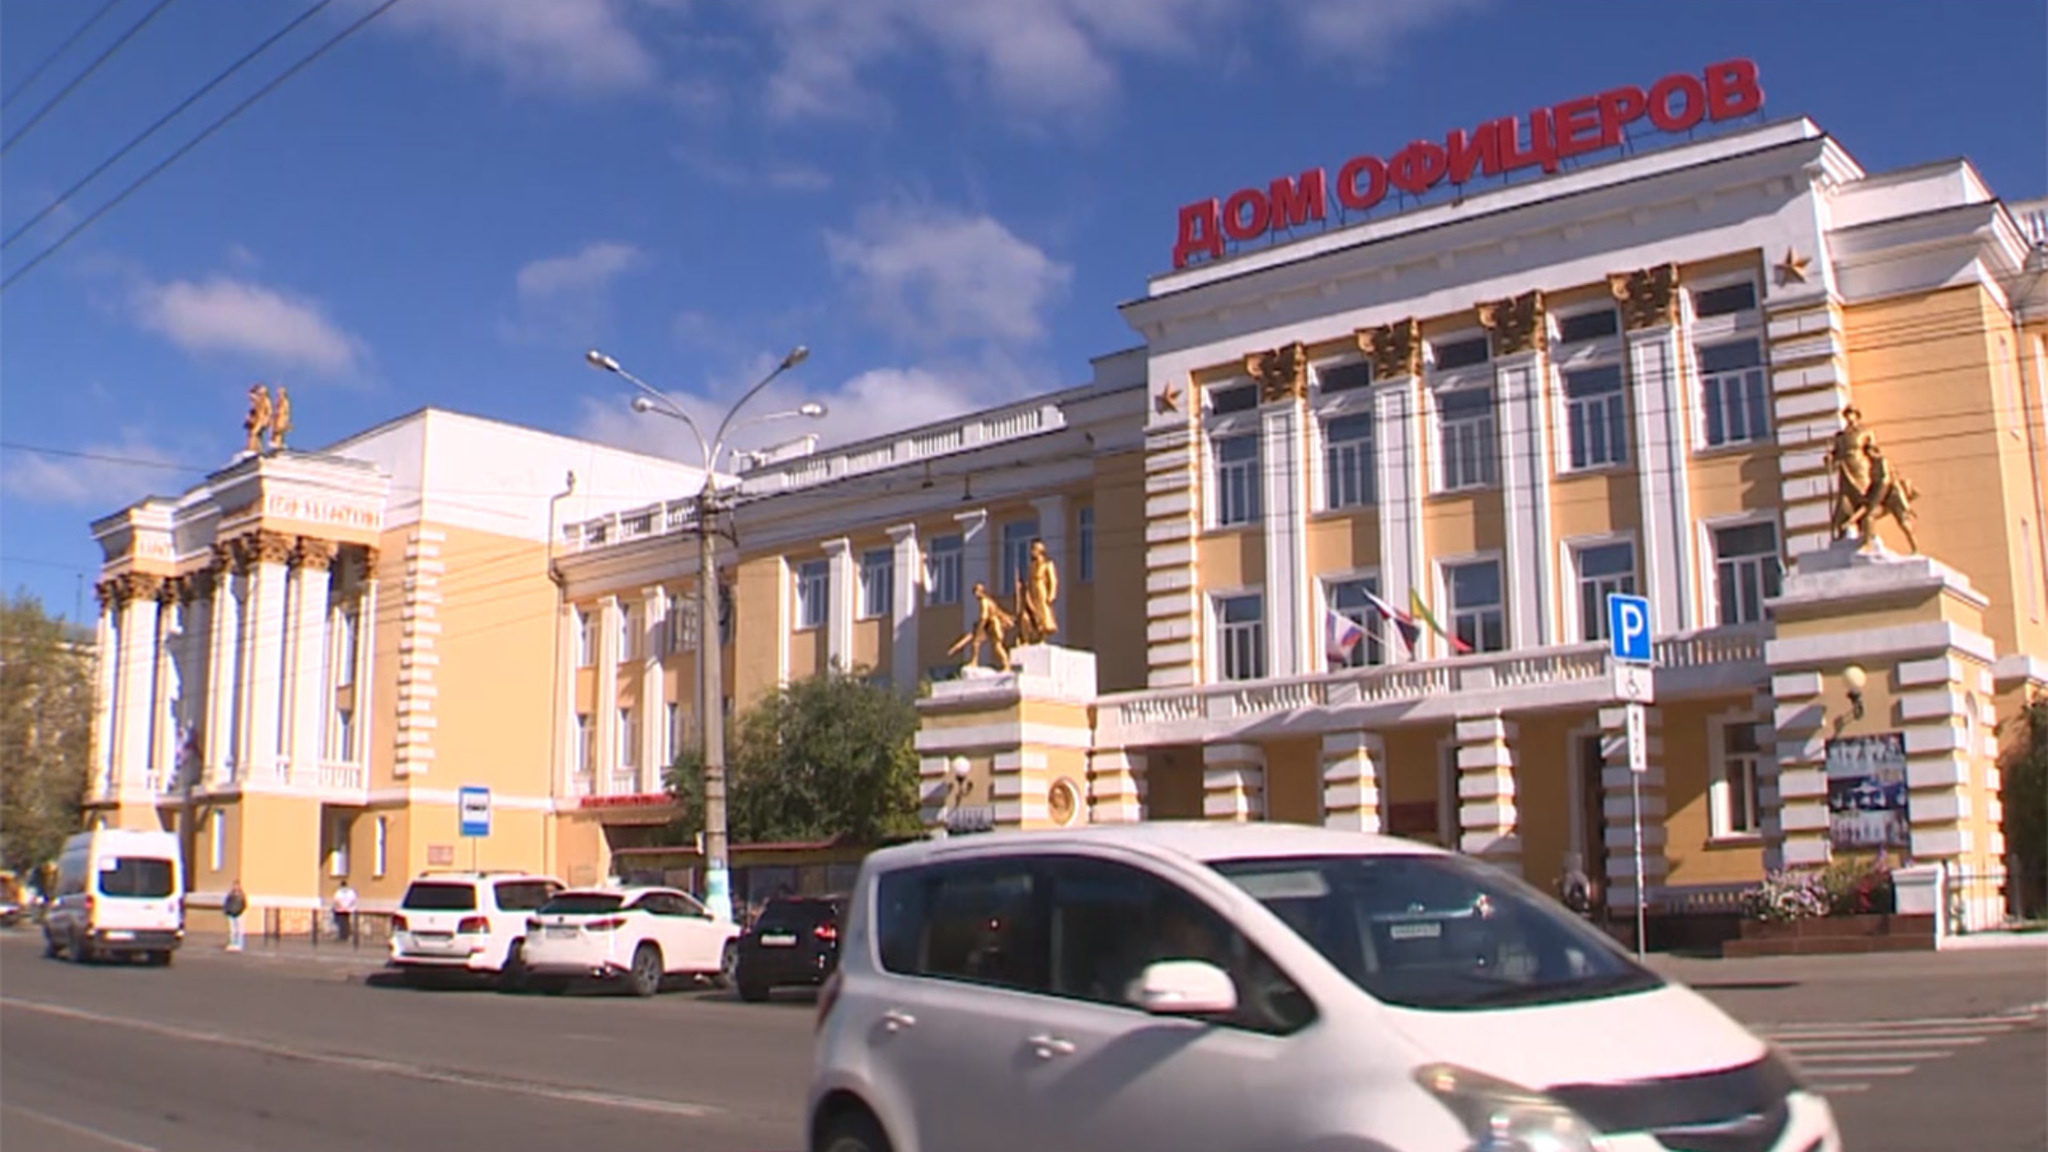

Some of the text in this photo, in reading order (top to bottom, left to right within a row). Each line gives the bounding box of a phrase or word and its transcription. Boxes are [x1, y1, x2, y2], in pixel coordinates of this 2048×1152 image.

[1173, 57, 1765, 269] ДОМ ОФИЦЕРОВ
[1620, 602, 1644, 654] P
